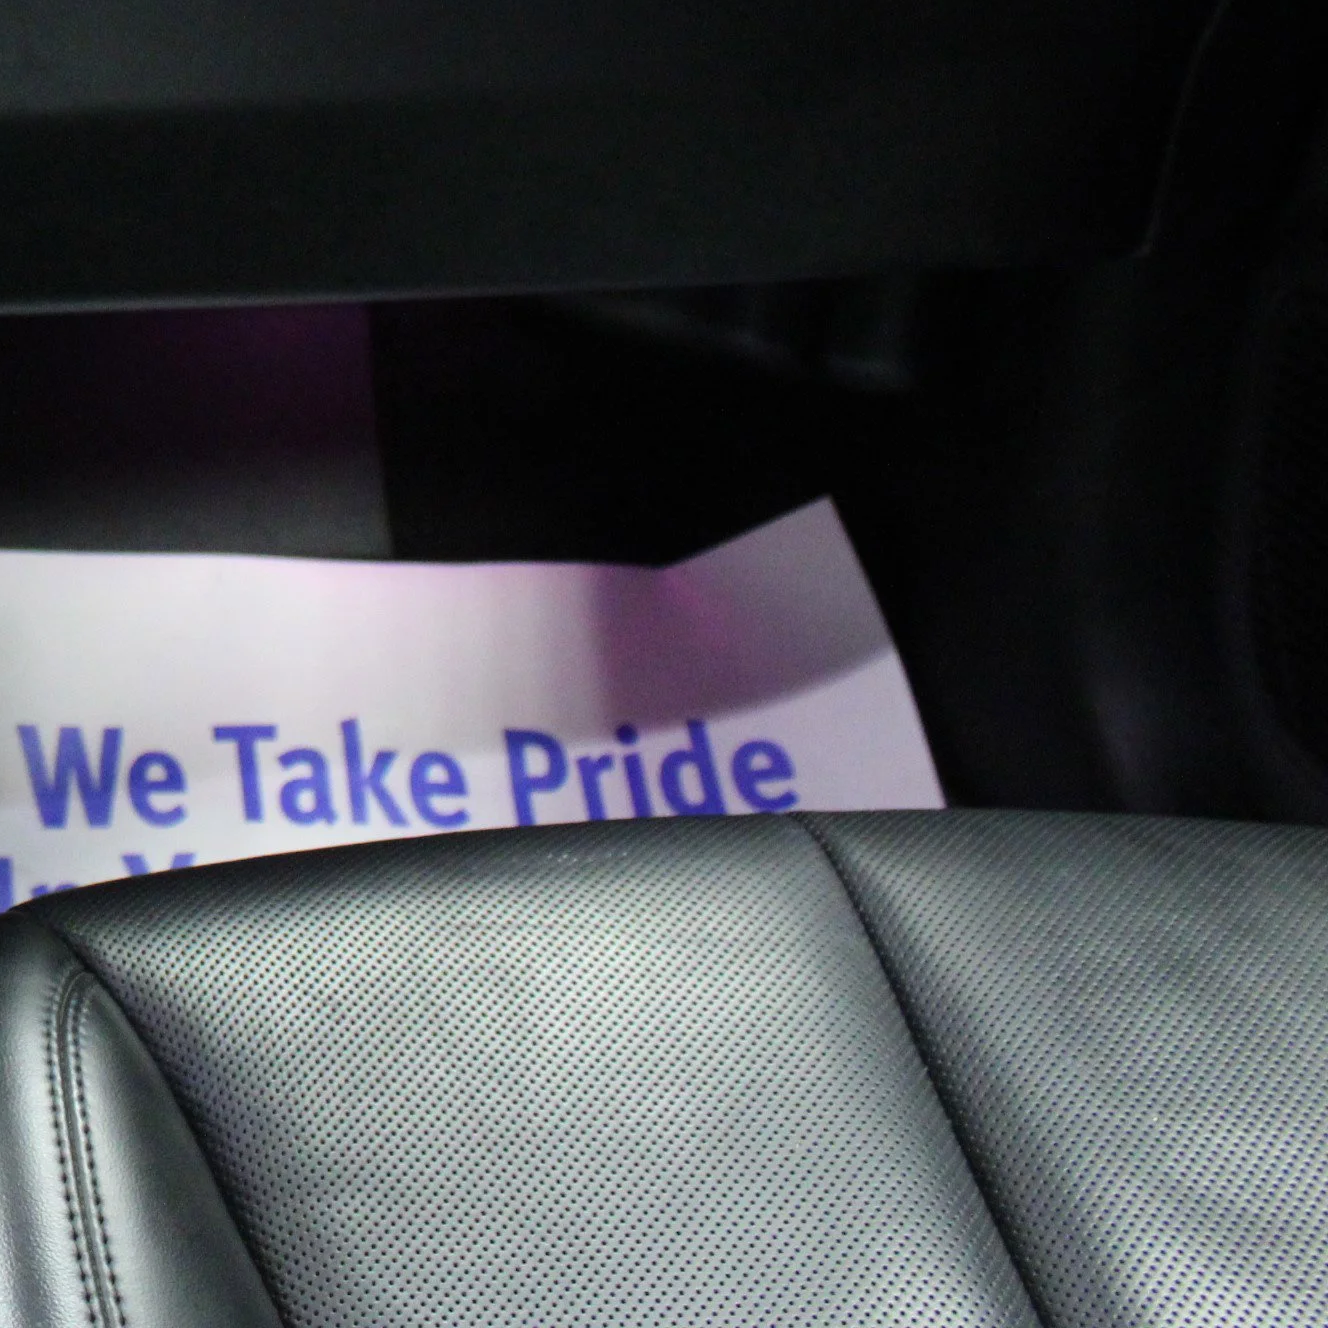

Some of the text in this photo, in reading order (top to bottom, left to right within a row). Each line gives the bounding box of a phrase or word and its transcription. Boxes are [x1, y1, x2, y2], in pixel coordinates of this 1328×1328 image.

[16, 717, 799, 829] We Take Pride
